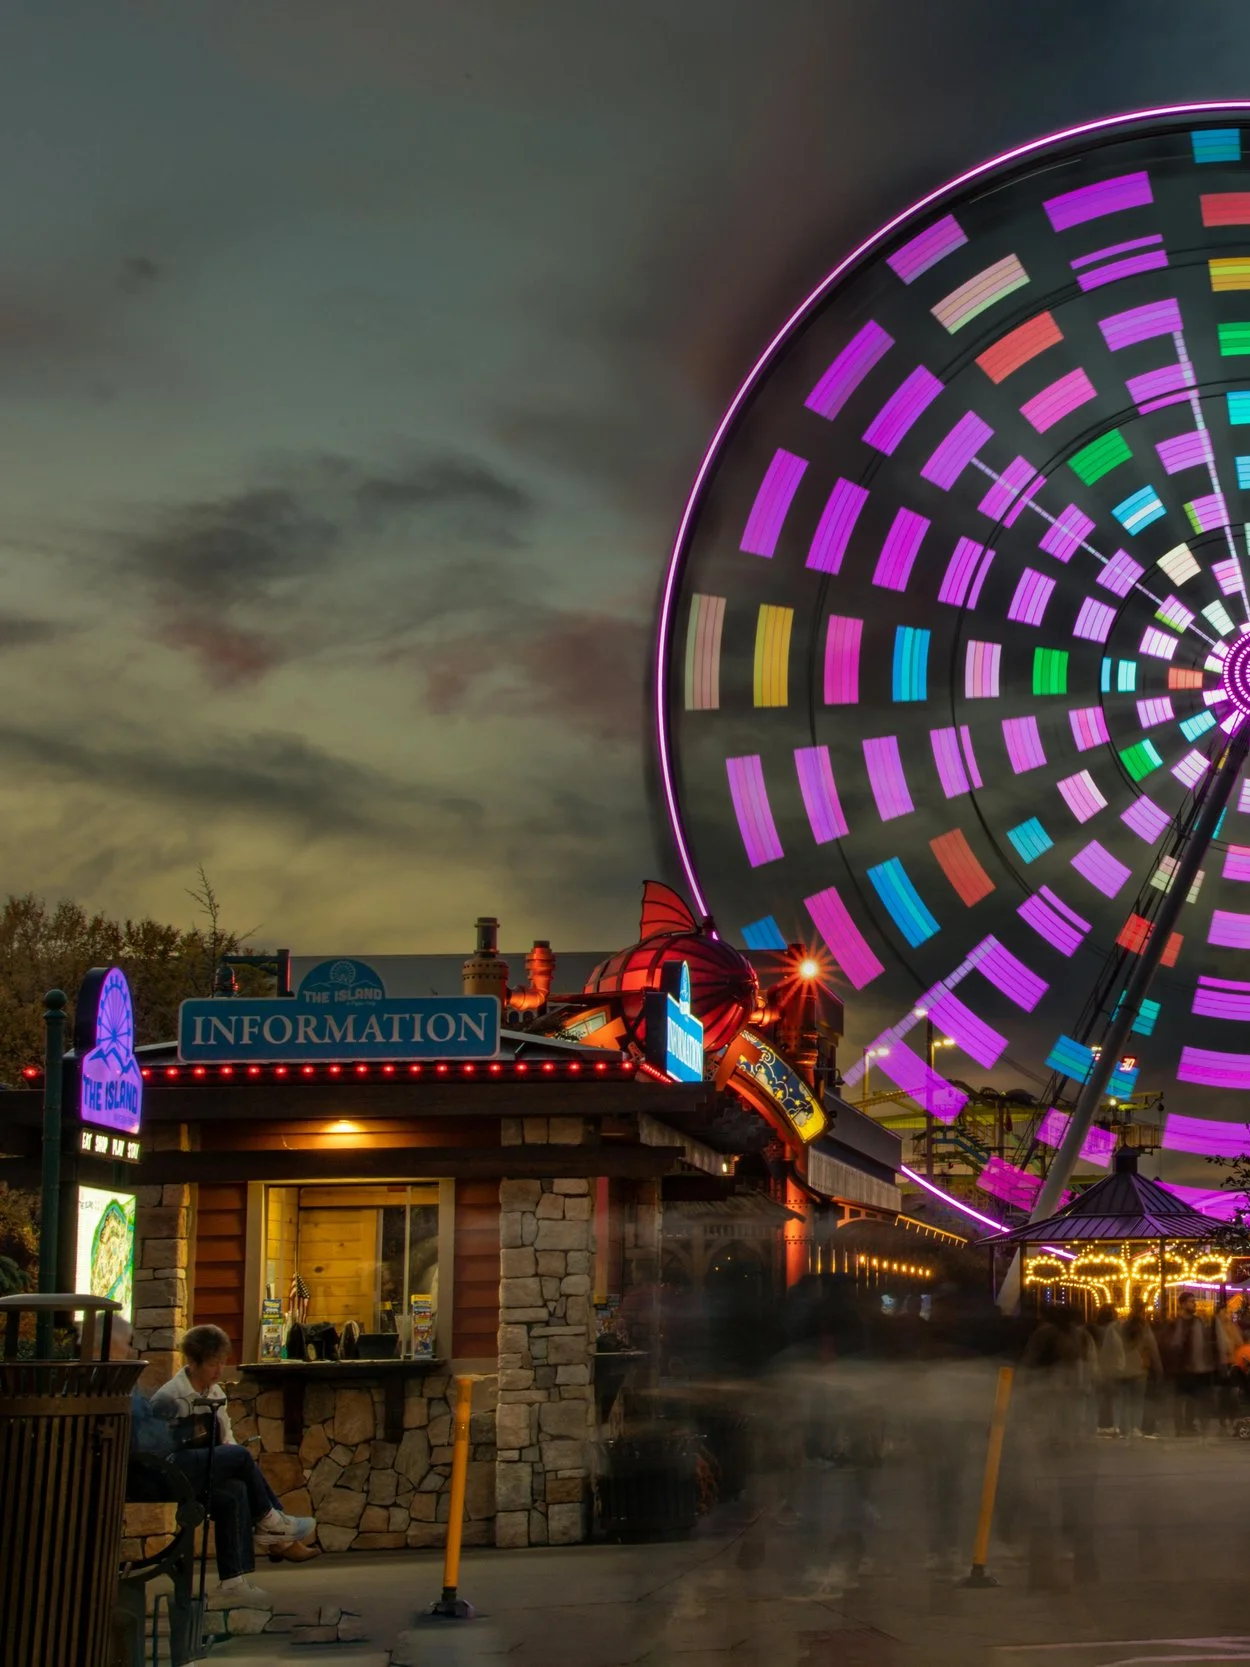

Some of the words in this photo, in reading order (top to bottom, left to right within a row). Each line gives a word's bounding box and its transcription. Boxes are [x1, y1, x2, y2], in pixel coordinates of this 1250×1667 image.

[303, 990, 330, 1003] THE
[334, 987, 382, 1003] ISLAND
[191, 1012, 488, 1045] INFORMATION
[83, 1074, 103, 1111] THE
[105, 1080, 138, 1115] ISLAND
